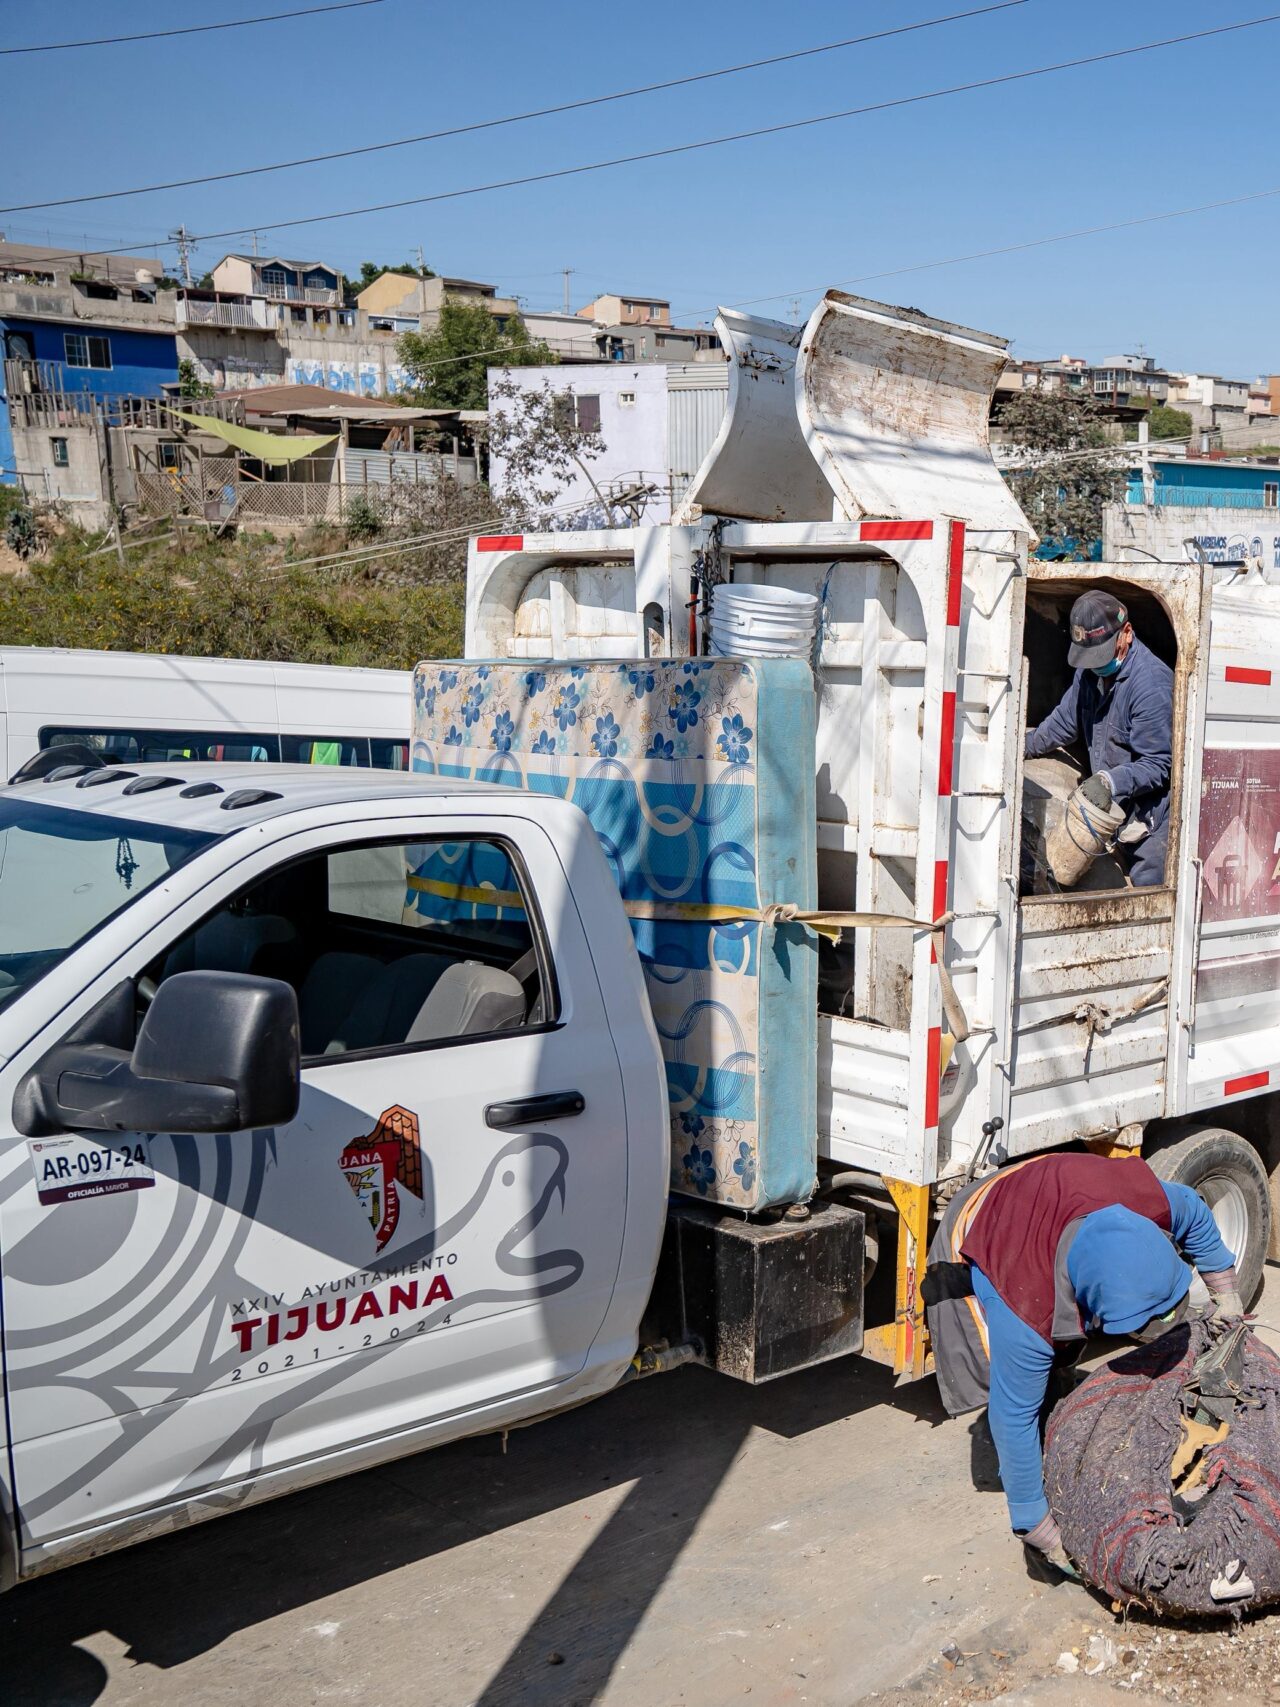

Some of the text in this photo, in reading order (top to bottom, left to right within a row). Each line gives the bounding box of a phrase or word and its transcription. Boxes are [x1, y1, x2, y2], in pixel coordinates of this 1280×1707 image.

[1212, 781, 1239, 789] TIJUANA
[43, 1143, 146, 1181] AR-097-24
[67, 1182, 130, 1199] OFICIALÍA MAYOR
[384, 1180, 395, 1232] PATRIA
[232, 1253, 458, 1316] XXIV AYUNTAMIENTO
[231, 1273, 455, 1353] TIJUANA
